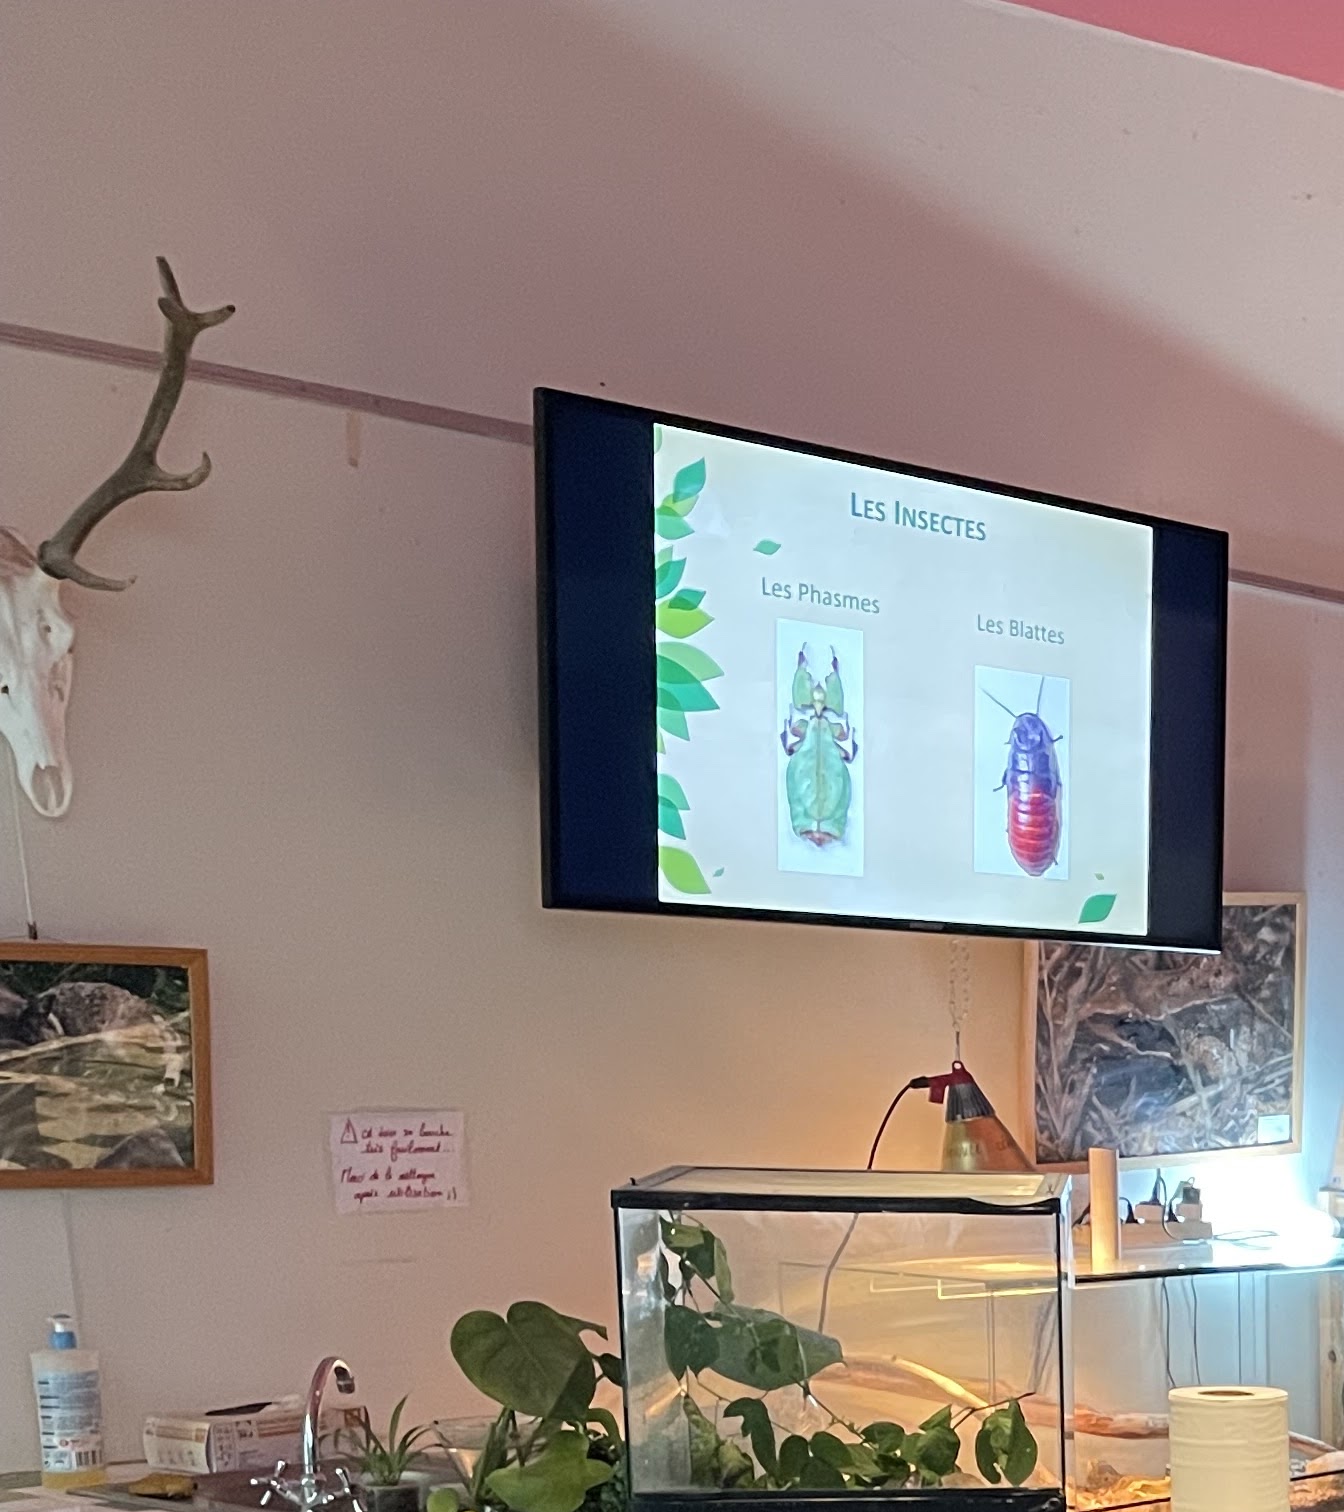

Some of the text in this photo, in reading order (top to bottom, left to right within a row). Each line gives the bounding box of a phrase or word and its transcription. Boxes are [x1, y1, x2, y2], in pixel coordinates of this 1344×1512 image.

[762, 576, 880, 614] Les Phasmes
[977, 613, 1065, 645] Les Blattes
